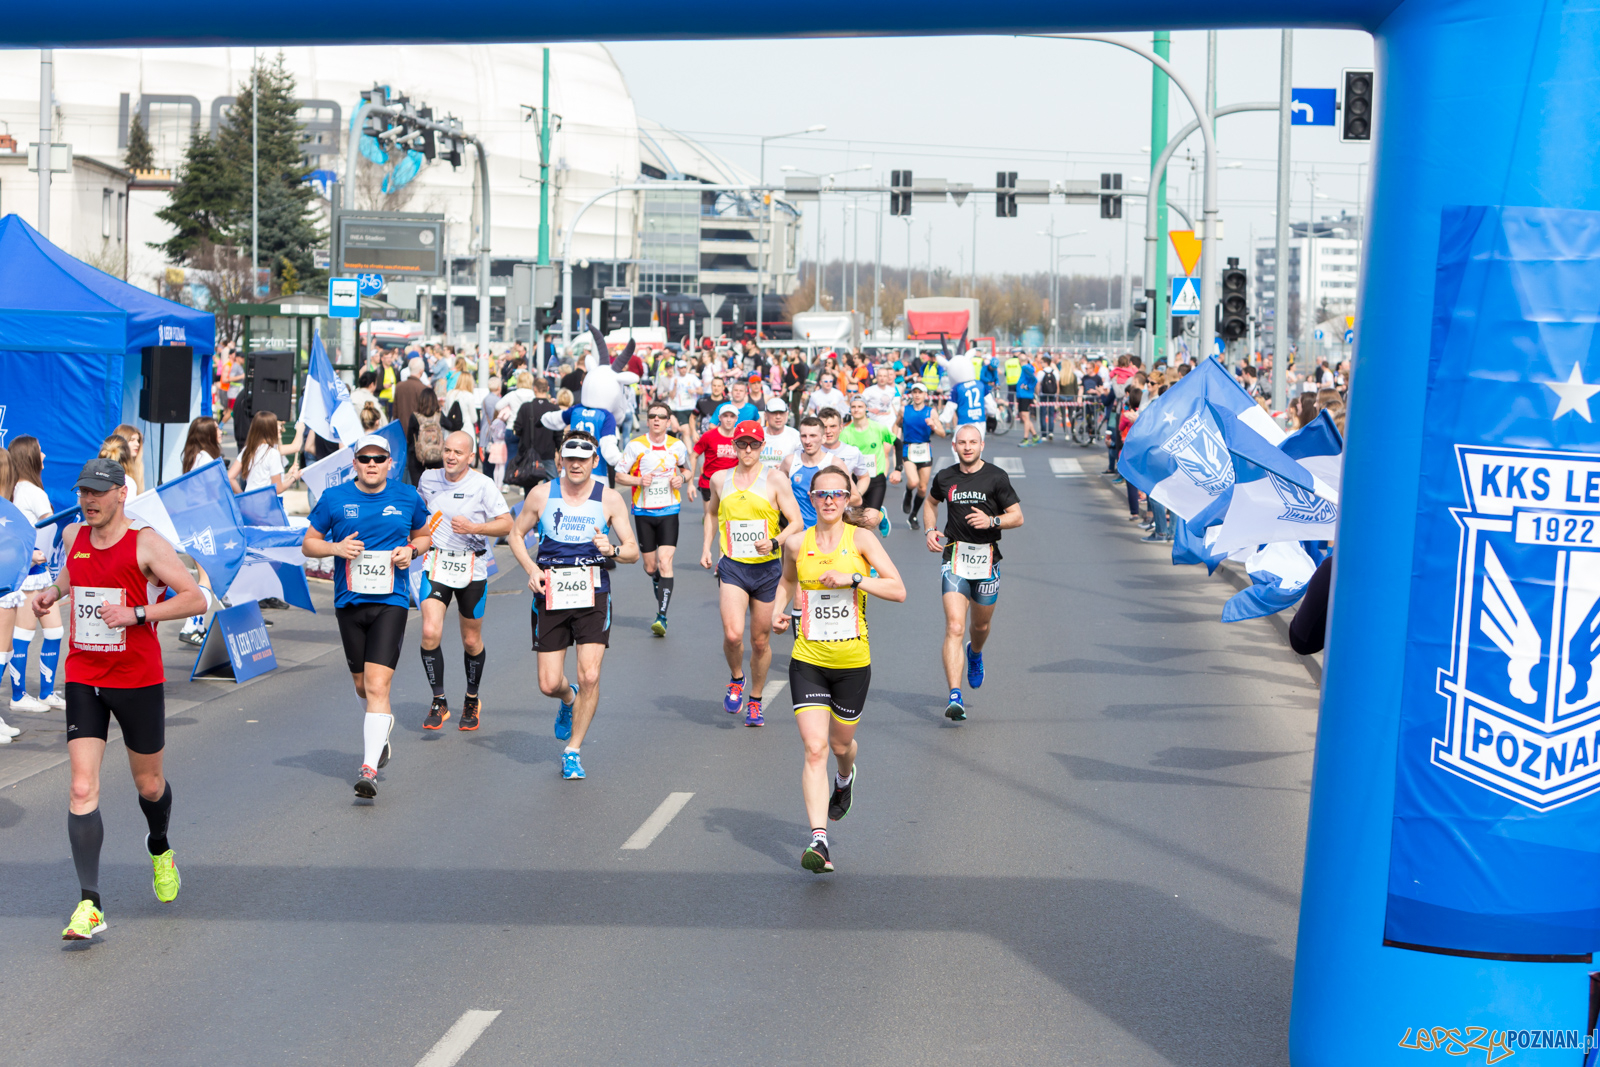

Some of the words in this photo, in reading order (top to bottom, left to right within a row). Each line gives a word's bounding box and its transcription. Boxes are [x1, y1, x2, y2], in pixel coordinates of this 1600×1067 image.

[266, 336, 284, 348] ztm
[965, 387, 981, 408] 12
[1481, 464, 1551, 502] KKS
[1565, 470, 1600, 503] LE
[648, 487, 669, 496] 5355
[952, 489, 987, 502] HUSARIA
[562, 515, 596, 525] RUNNERS
[560, 523, 586, 532] POWER
[1533, 516, 1594, 544] 1922
[564, 534, 580, 542] ŚREM
[732, 531, 765, 542] 12000
[961, 553, 988, 564] 11672
[357, 564, 386, 576] 1342
[441, 560, 467, 573] 3755
[556, 580, 587, 592] 2468
[78, 604, 103, 619] 390
[815, 605, 849, 619] 8556
[235, 632, 253, 656] LECH
[247, 622, 271, 652] POZNAŃ
